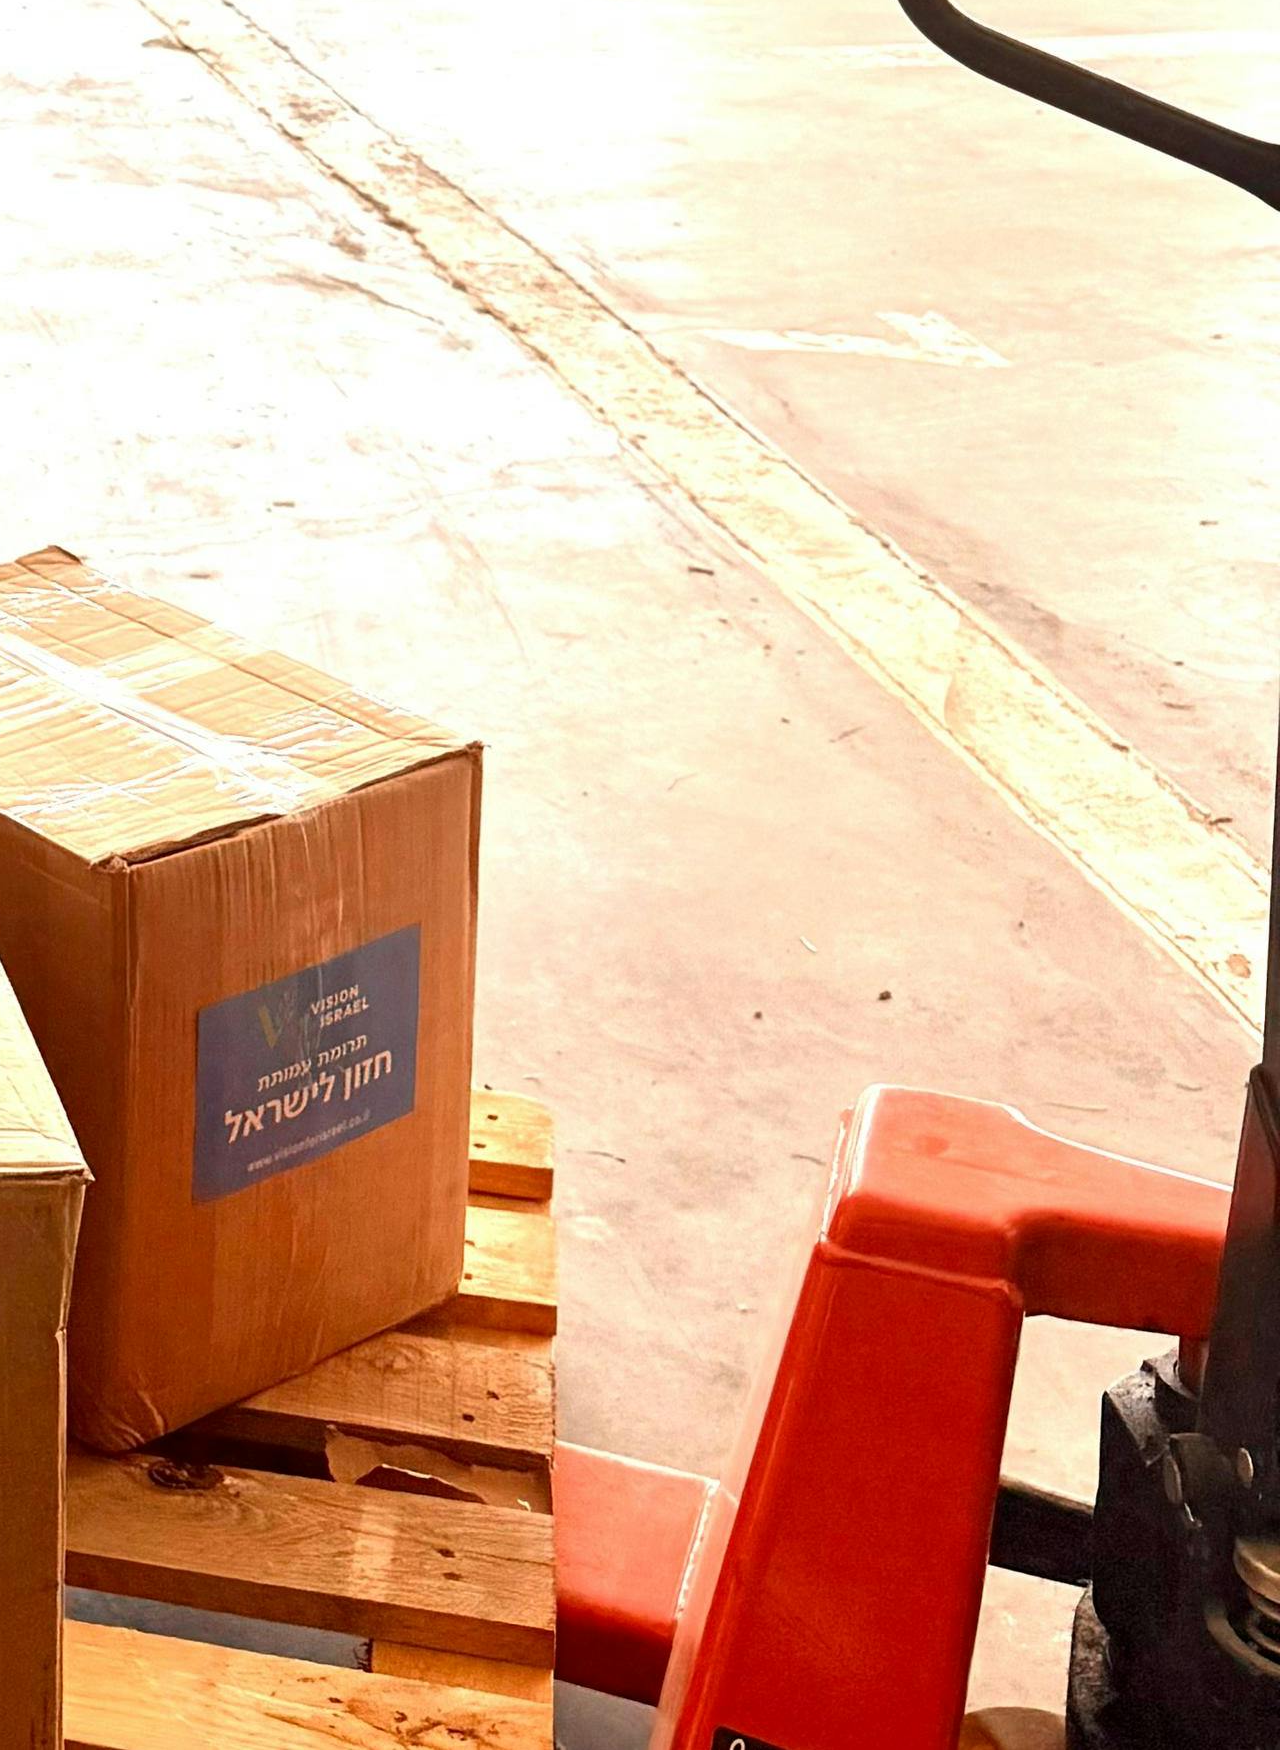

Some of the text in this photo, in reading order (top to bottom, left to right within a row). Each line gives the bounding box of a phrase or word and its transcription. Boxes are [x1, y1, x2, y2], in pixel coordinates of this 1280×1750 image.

[310, 984, 360, 1016] VISION
[320, 996, 370, 1029] ISRAEL
[257, 1034, 368, 1093] תרומת עמותת
[224, 1049, 393, 1144] חזון לישראל
